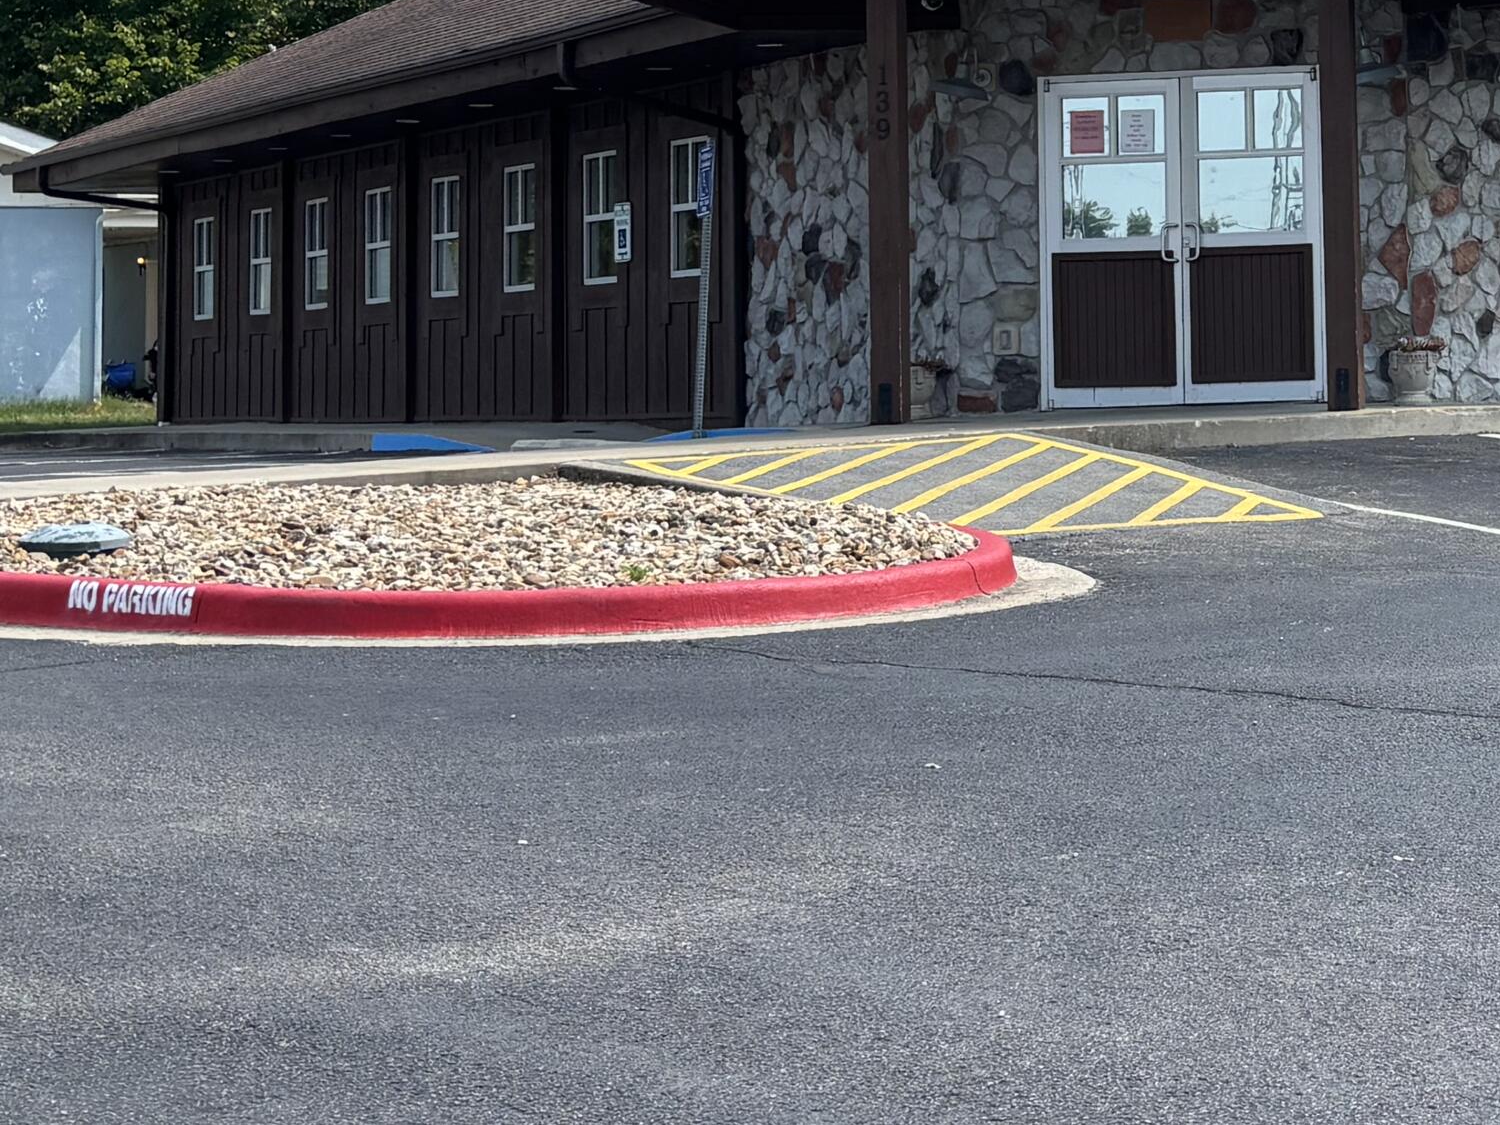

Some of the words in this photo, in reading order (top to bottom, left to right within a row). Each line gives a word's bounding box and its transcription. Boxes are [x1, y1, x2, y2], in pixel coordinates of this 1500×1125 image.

[876, 62, 891, 140] 139
[68, 579, 99, 612] NO
[102, 583, 196, 616] PARKING
